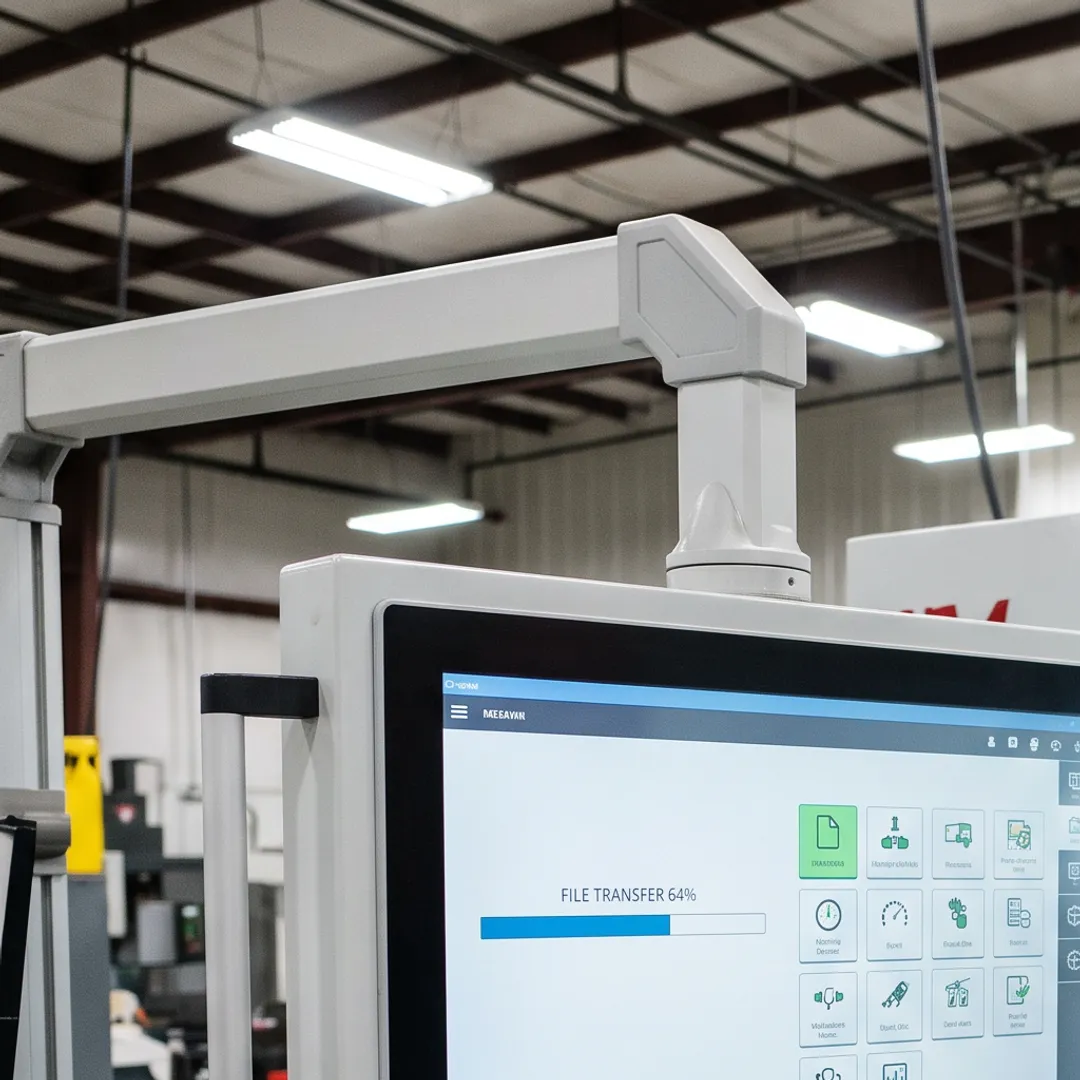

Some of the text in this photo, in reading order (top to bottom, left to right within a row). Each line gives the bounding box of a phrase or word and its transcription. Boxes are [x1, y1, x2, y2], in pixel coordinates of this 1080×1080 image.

[561, 887, 697, 903] FILE TRANSFER 64%
